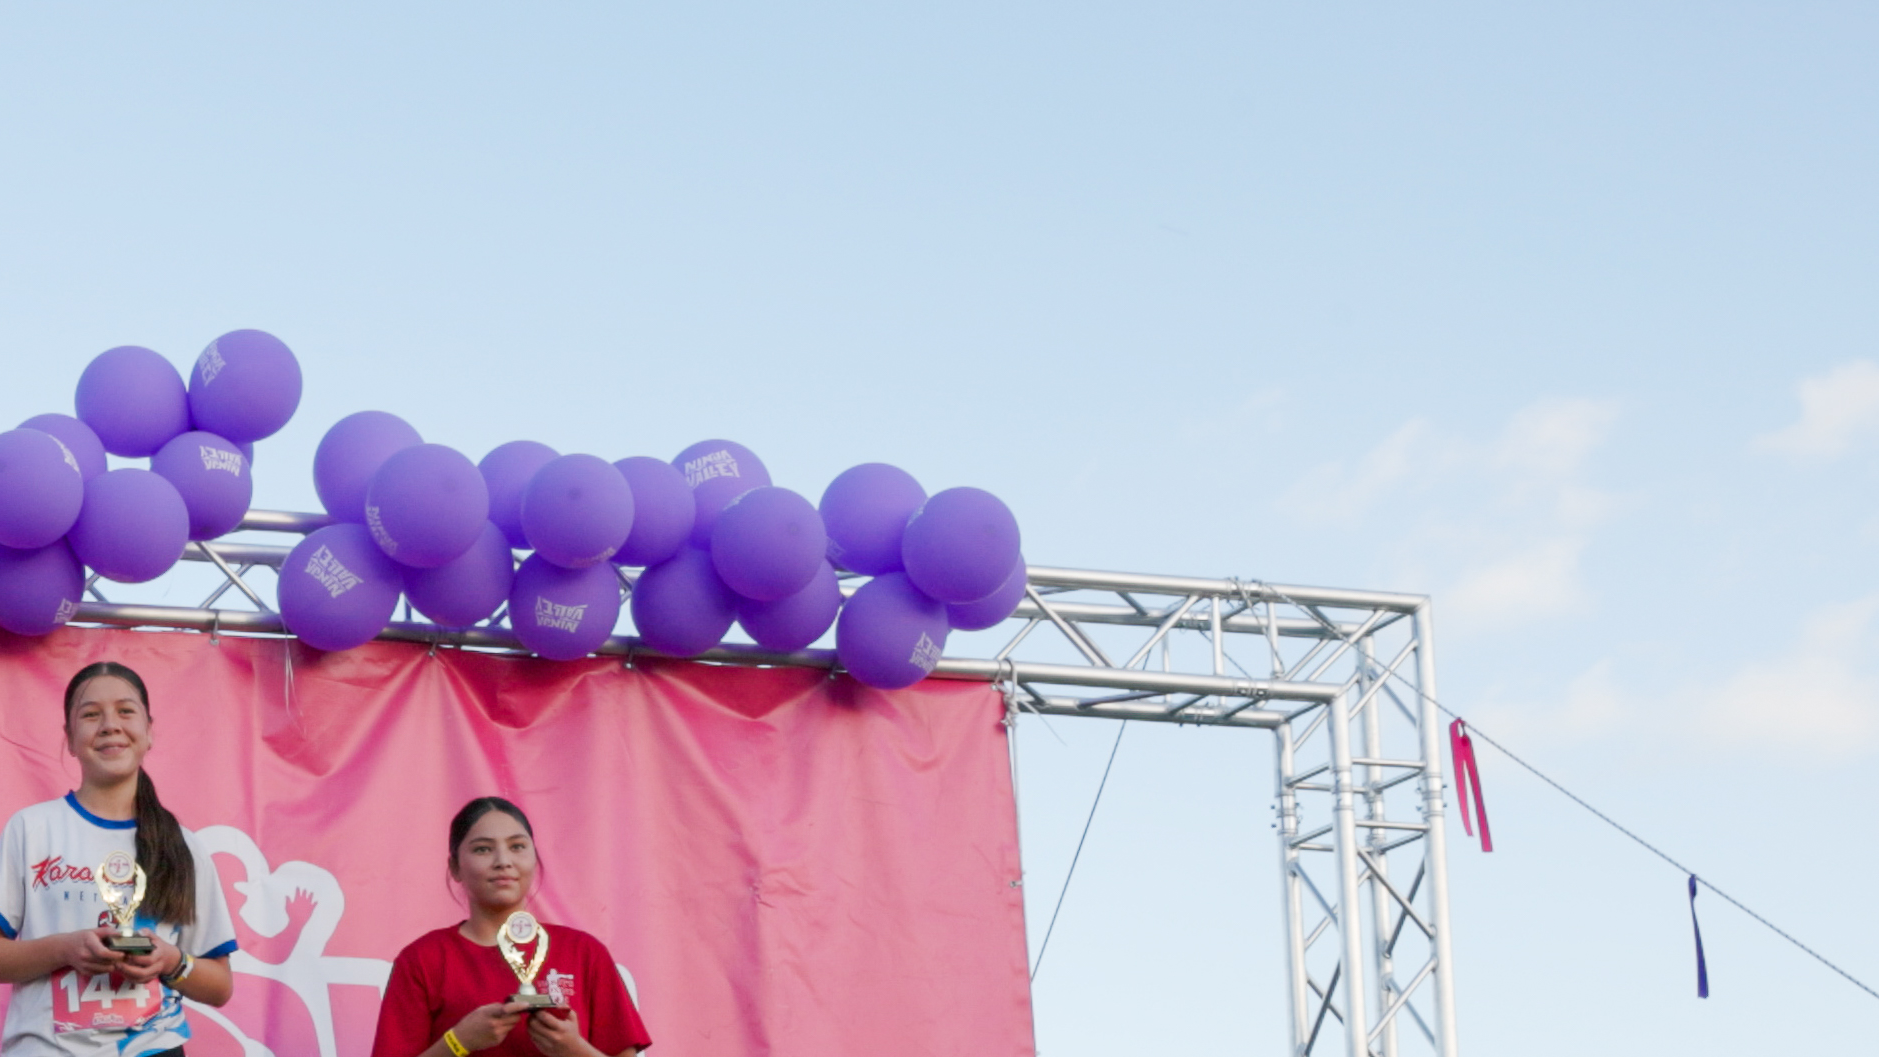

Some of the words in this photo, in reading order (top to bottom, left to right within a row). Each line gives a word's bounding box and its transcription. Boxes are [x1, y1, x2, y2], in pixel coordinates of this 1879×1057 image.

[202, 459, 240, 476] NINJA
[684, 450, 735, 476] NINJA
[686, 459, 740, 488] VALLEY
[305, 558, 347, 599] NINJA
[313, 544, 364, 591] VALLEY
[535, 596, 588, 620] VALLEY
[537, 613, 580, 633] NINJA
[61, 970, 151, 1013] 144
